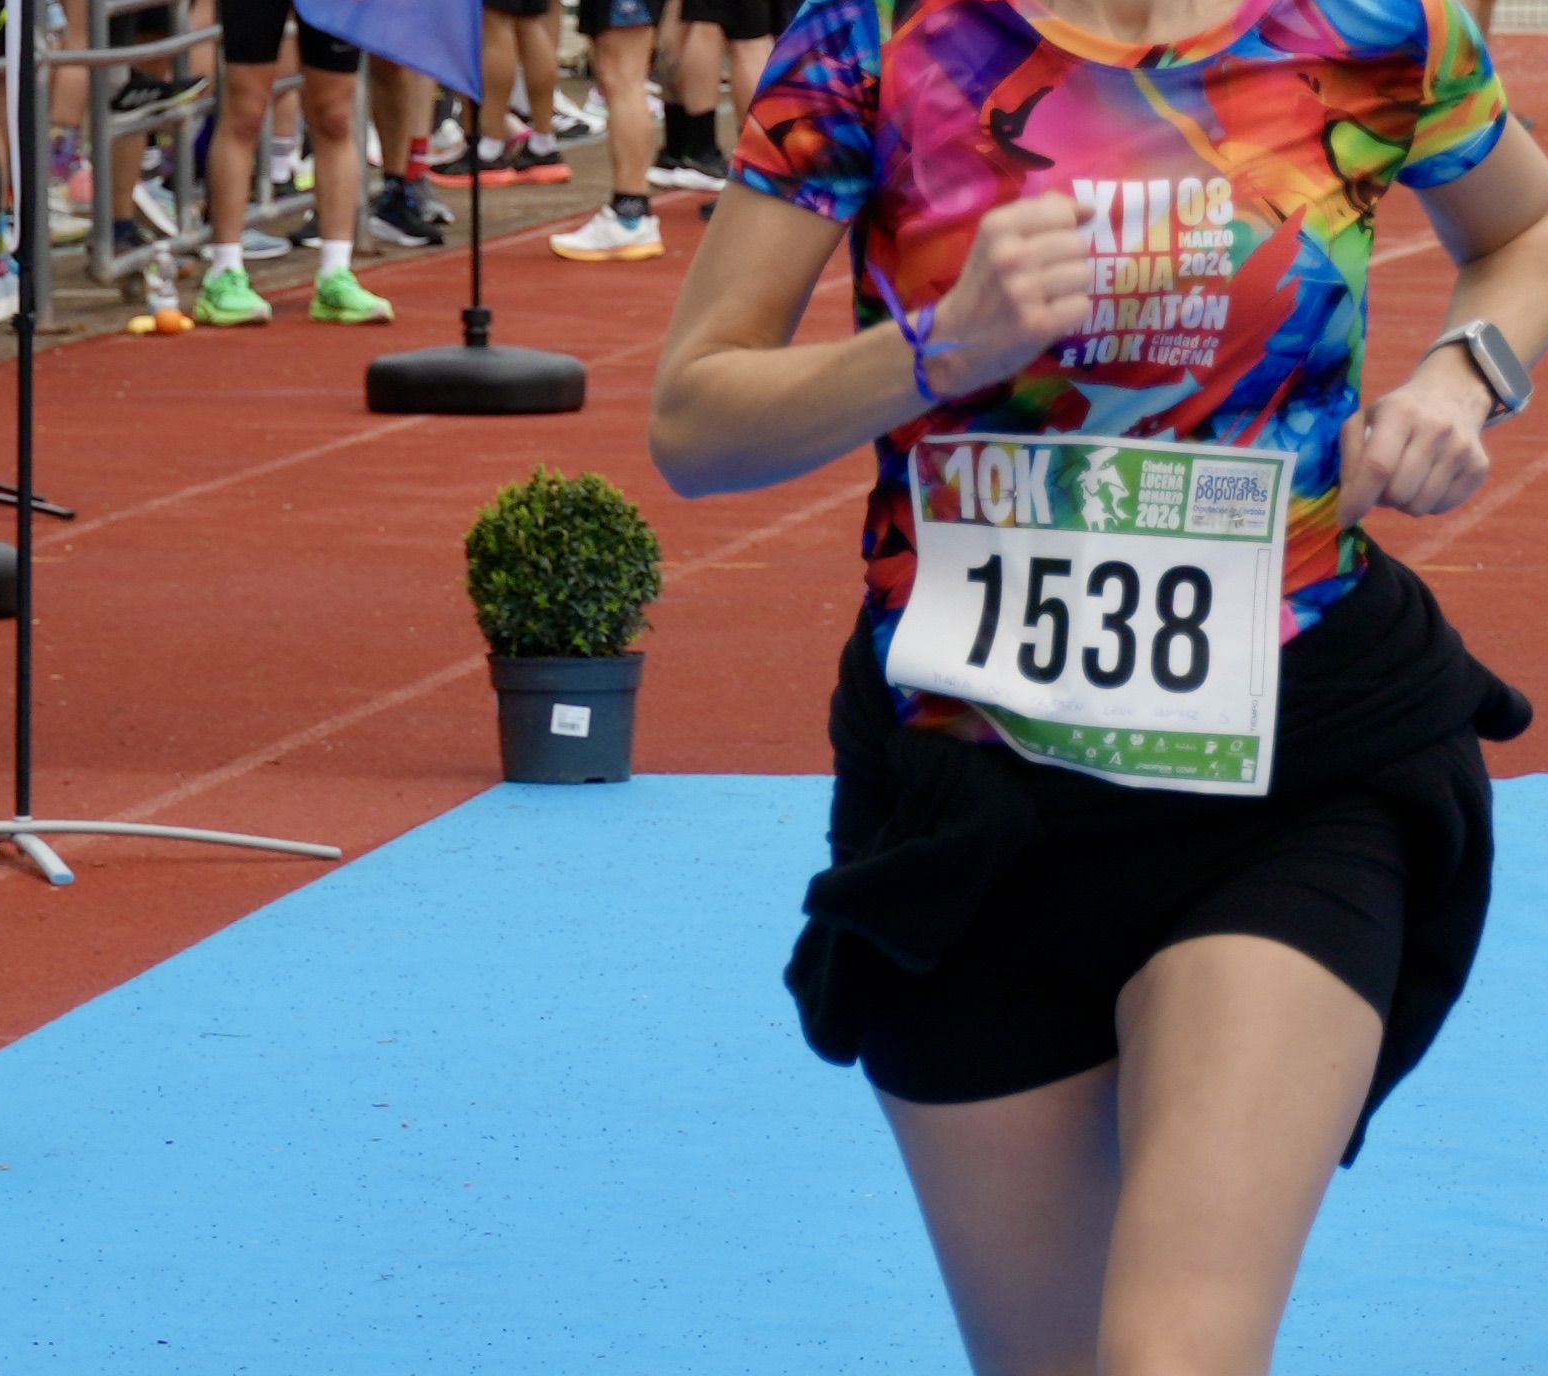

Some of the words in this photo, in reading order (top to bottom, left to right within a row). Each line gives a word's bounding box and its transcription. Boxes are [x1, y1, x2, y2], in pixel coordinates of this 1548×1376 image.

[1177, 177, 1234, 225] 08
[1072, 179, 1171, 253] XII
[1179, 230, 1234, 248] MARZO
[1179, 252, 1233, 277] 2026
[1084, 334, 1145, 365] 10K
[1148, 346, 1215, 367] LUCENA
[946, 445, 1053, 528] 10K
[1140, 473, 1184, 490] LUCENA
[1195, 485, 1268, 503] populares
[1197, 473, 1259, 490] carreras
[1136, 503, 1181, 530] 2026
[966, 554, 1213, 694] 1538
